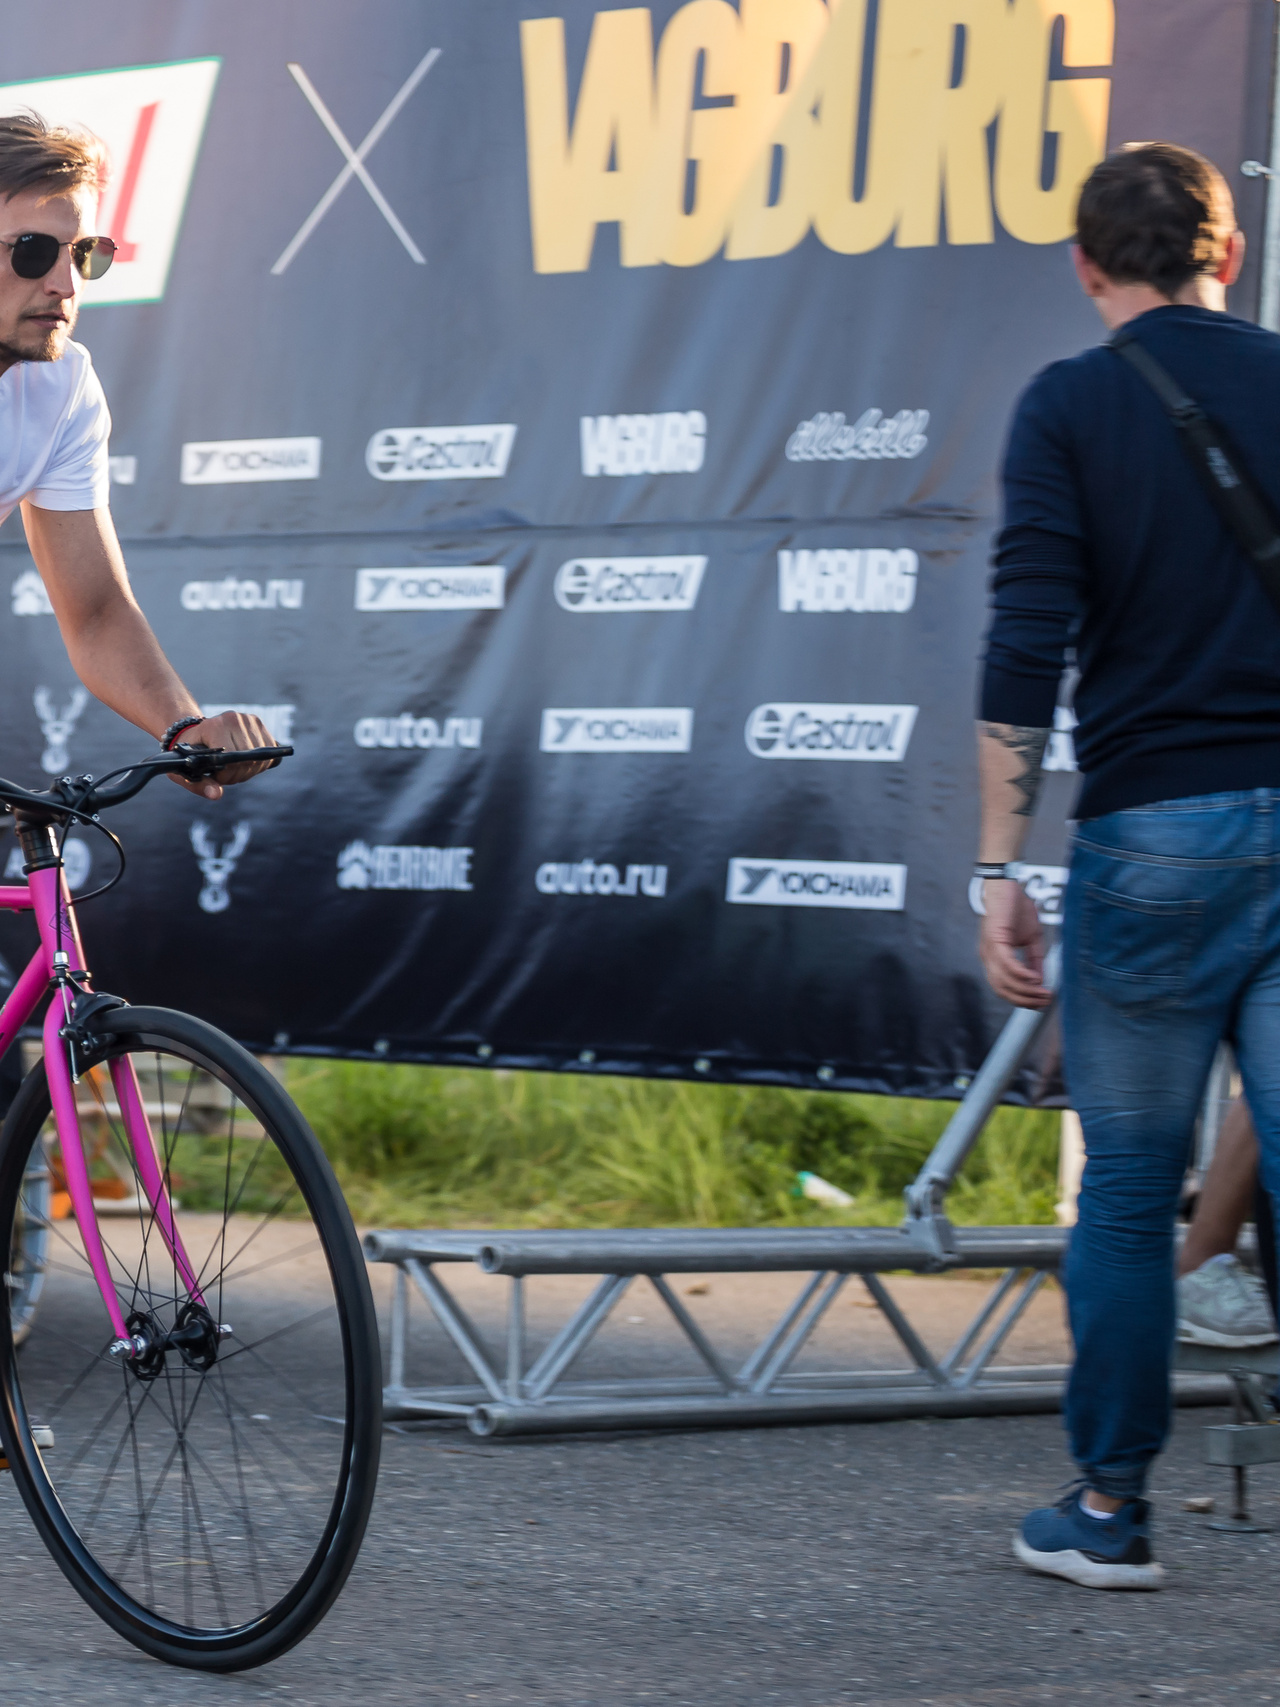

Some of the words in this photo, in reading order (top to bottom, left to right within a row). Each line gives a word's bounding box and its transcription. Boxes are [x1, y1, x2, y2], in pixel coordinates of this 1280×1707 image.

[404, 432, 504, 470] Castrol
[181, 576, 303, 610] auto.ru
[593, 564, 692, 602] Castrol
[353, 712, 483, 748] auto.ru
[786, 712, 901, 750] Castrol
[535, 858, 668, 897] auto.ru
[778, 871, 894, 897] YOKOHAMA
